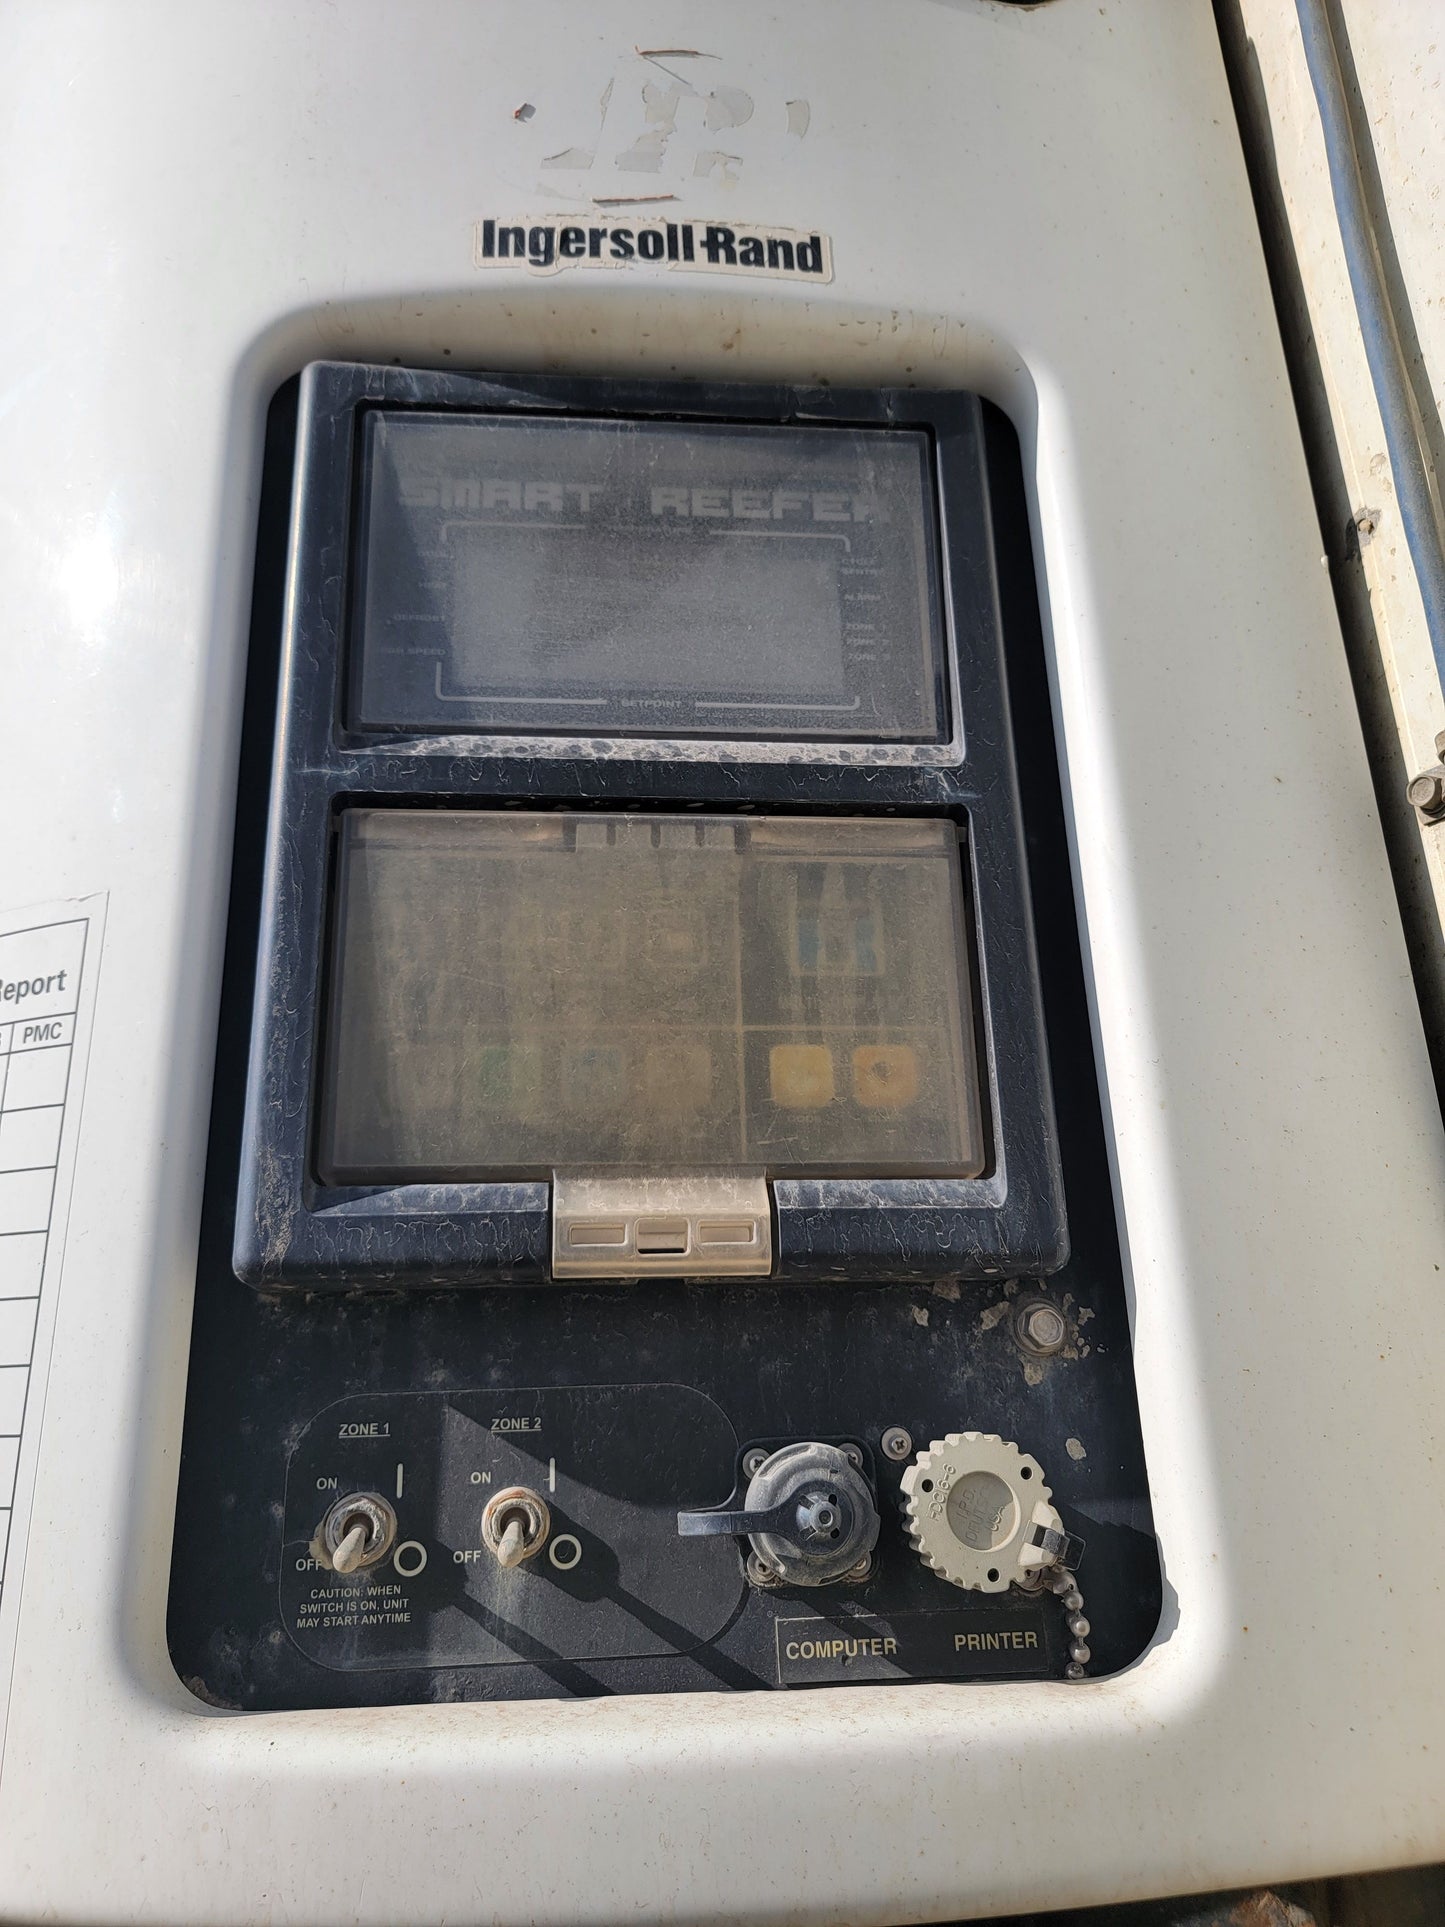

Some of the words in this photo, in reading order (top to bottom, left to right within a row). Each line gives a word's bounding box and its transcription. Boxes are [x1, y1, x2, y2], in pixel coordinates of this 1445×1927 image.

[400, 476, 604, 512] SMART
[23, 1021, 63, 1044] PMC
[339, 1422, 379, 1436] ZONE
[383, 1422, 390, 1435] 1
[491, 1417, 530, 1430] ZONE
[533, 1416, 542, 1429] 2
[316, 1477, 338, 1490] ON
[470, 1471, 491, 1484] ON
[295, 1558, 323, 1571] OFF
[452, 1550, 482, 1564] OFF
[310, 1587, 364, 1599] CAUTION:
[367, 1584, 401, 1596] WHEN
[300, 1602, 344, 1614] SWITCH
[346, 1601, 357, 1612] IS
[383, 1598, 409, 1610] UNIT
[296, 1617, 320, 1629] MAY
[323, 1615, 359, 1627] START
[361, 1612, 412, 1625] ANYTIME
[785, 1637, 898, 1660] COMPUTER
[954, 1631, 1039, 1652] PRINTER
